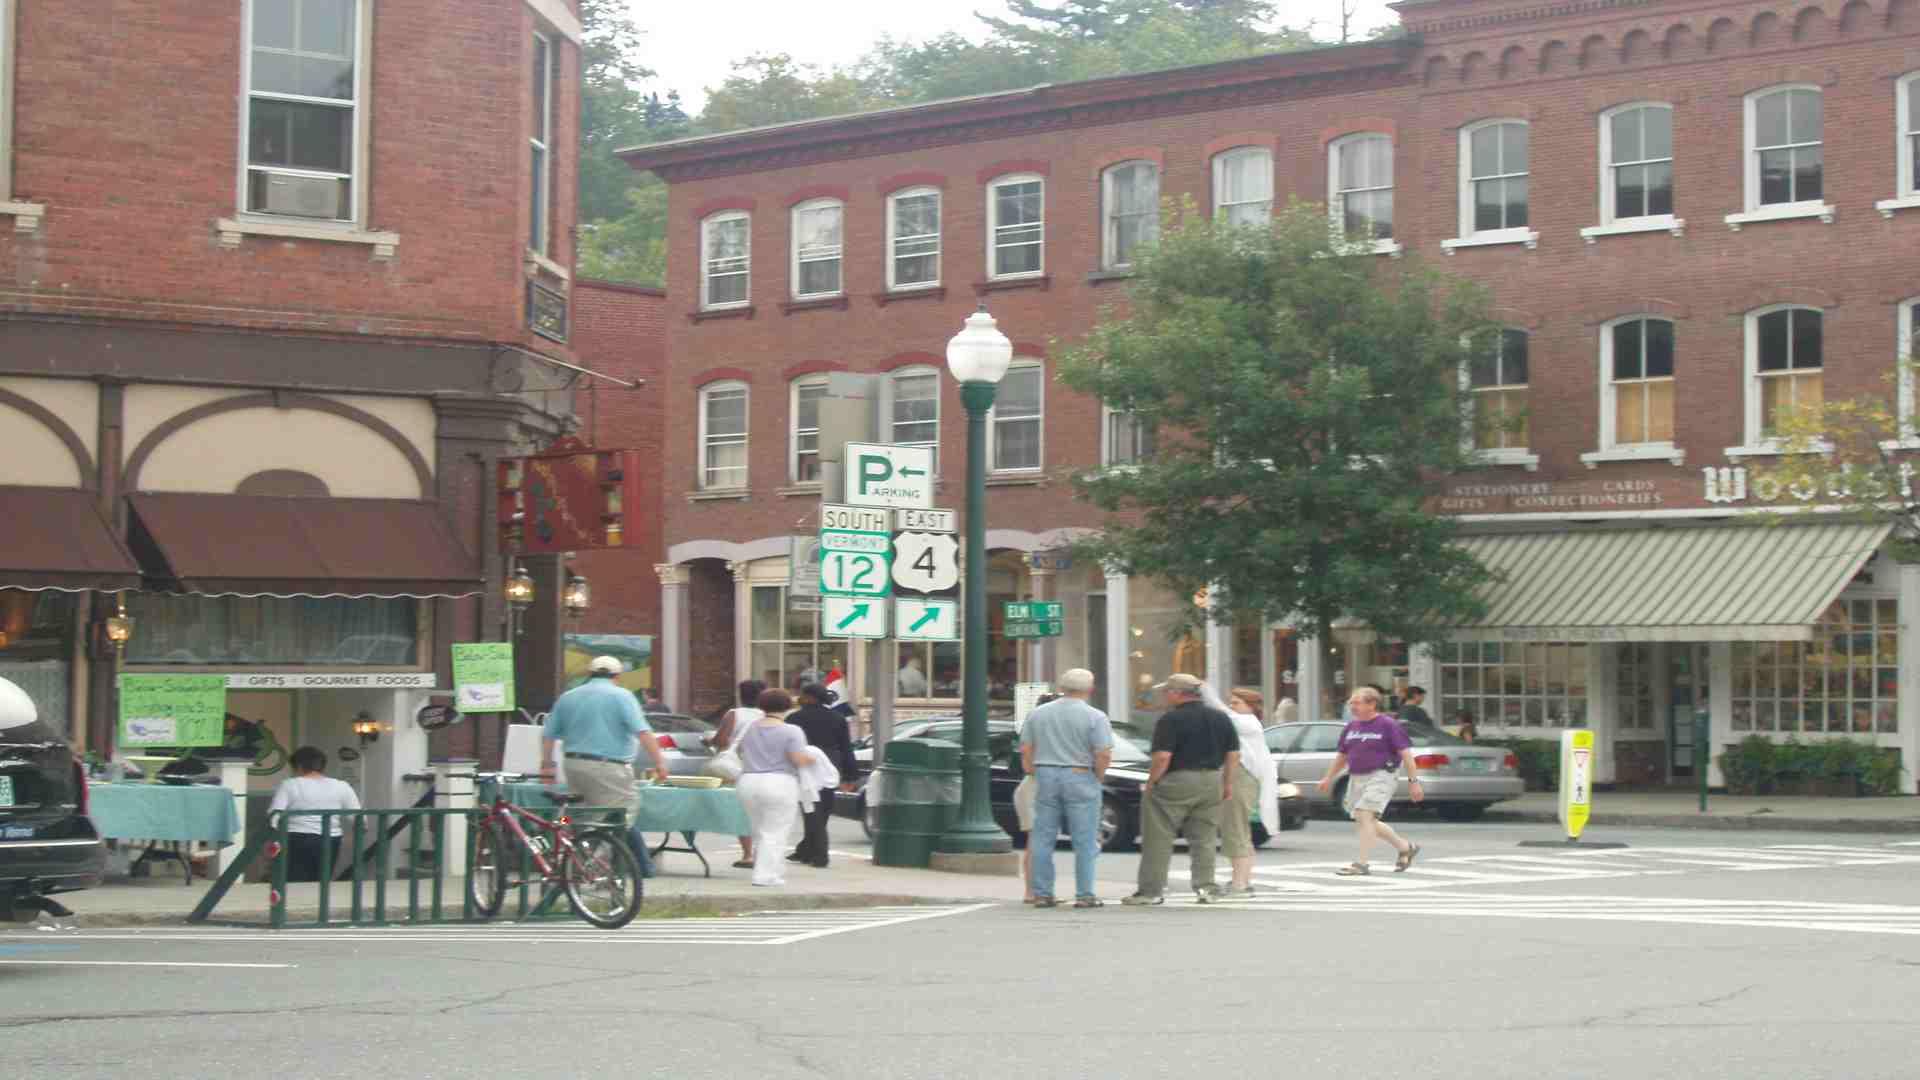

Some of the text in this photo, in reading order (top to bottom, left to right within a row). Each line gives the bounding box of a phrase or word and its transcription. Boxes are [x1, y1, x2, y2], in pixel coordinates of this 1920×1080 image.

[857, 453, 921, 499] PARKING
[1454, 479, 1657, 497] STATIONERY CARDS
[1440, 492, 1665, 509] GIFTS CONFECTIONERIES
[824, 510, 885, 532] SOUTH
[905, 510, 946, 529] EAST
[834, 554, 874, 590] 12
[911, 546, 937, 579] 4
[1007, 604, 1061, 618] ELM ST
[249, 676, 421, 686] GIFTS GOURMET FOODS
